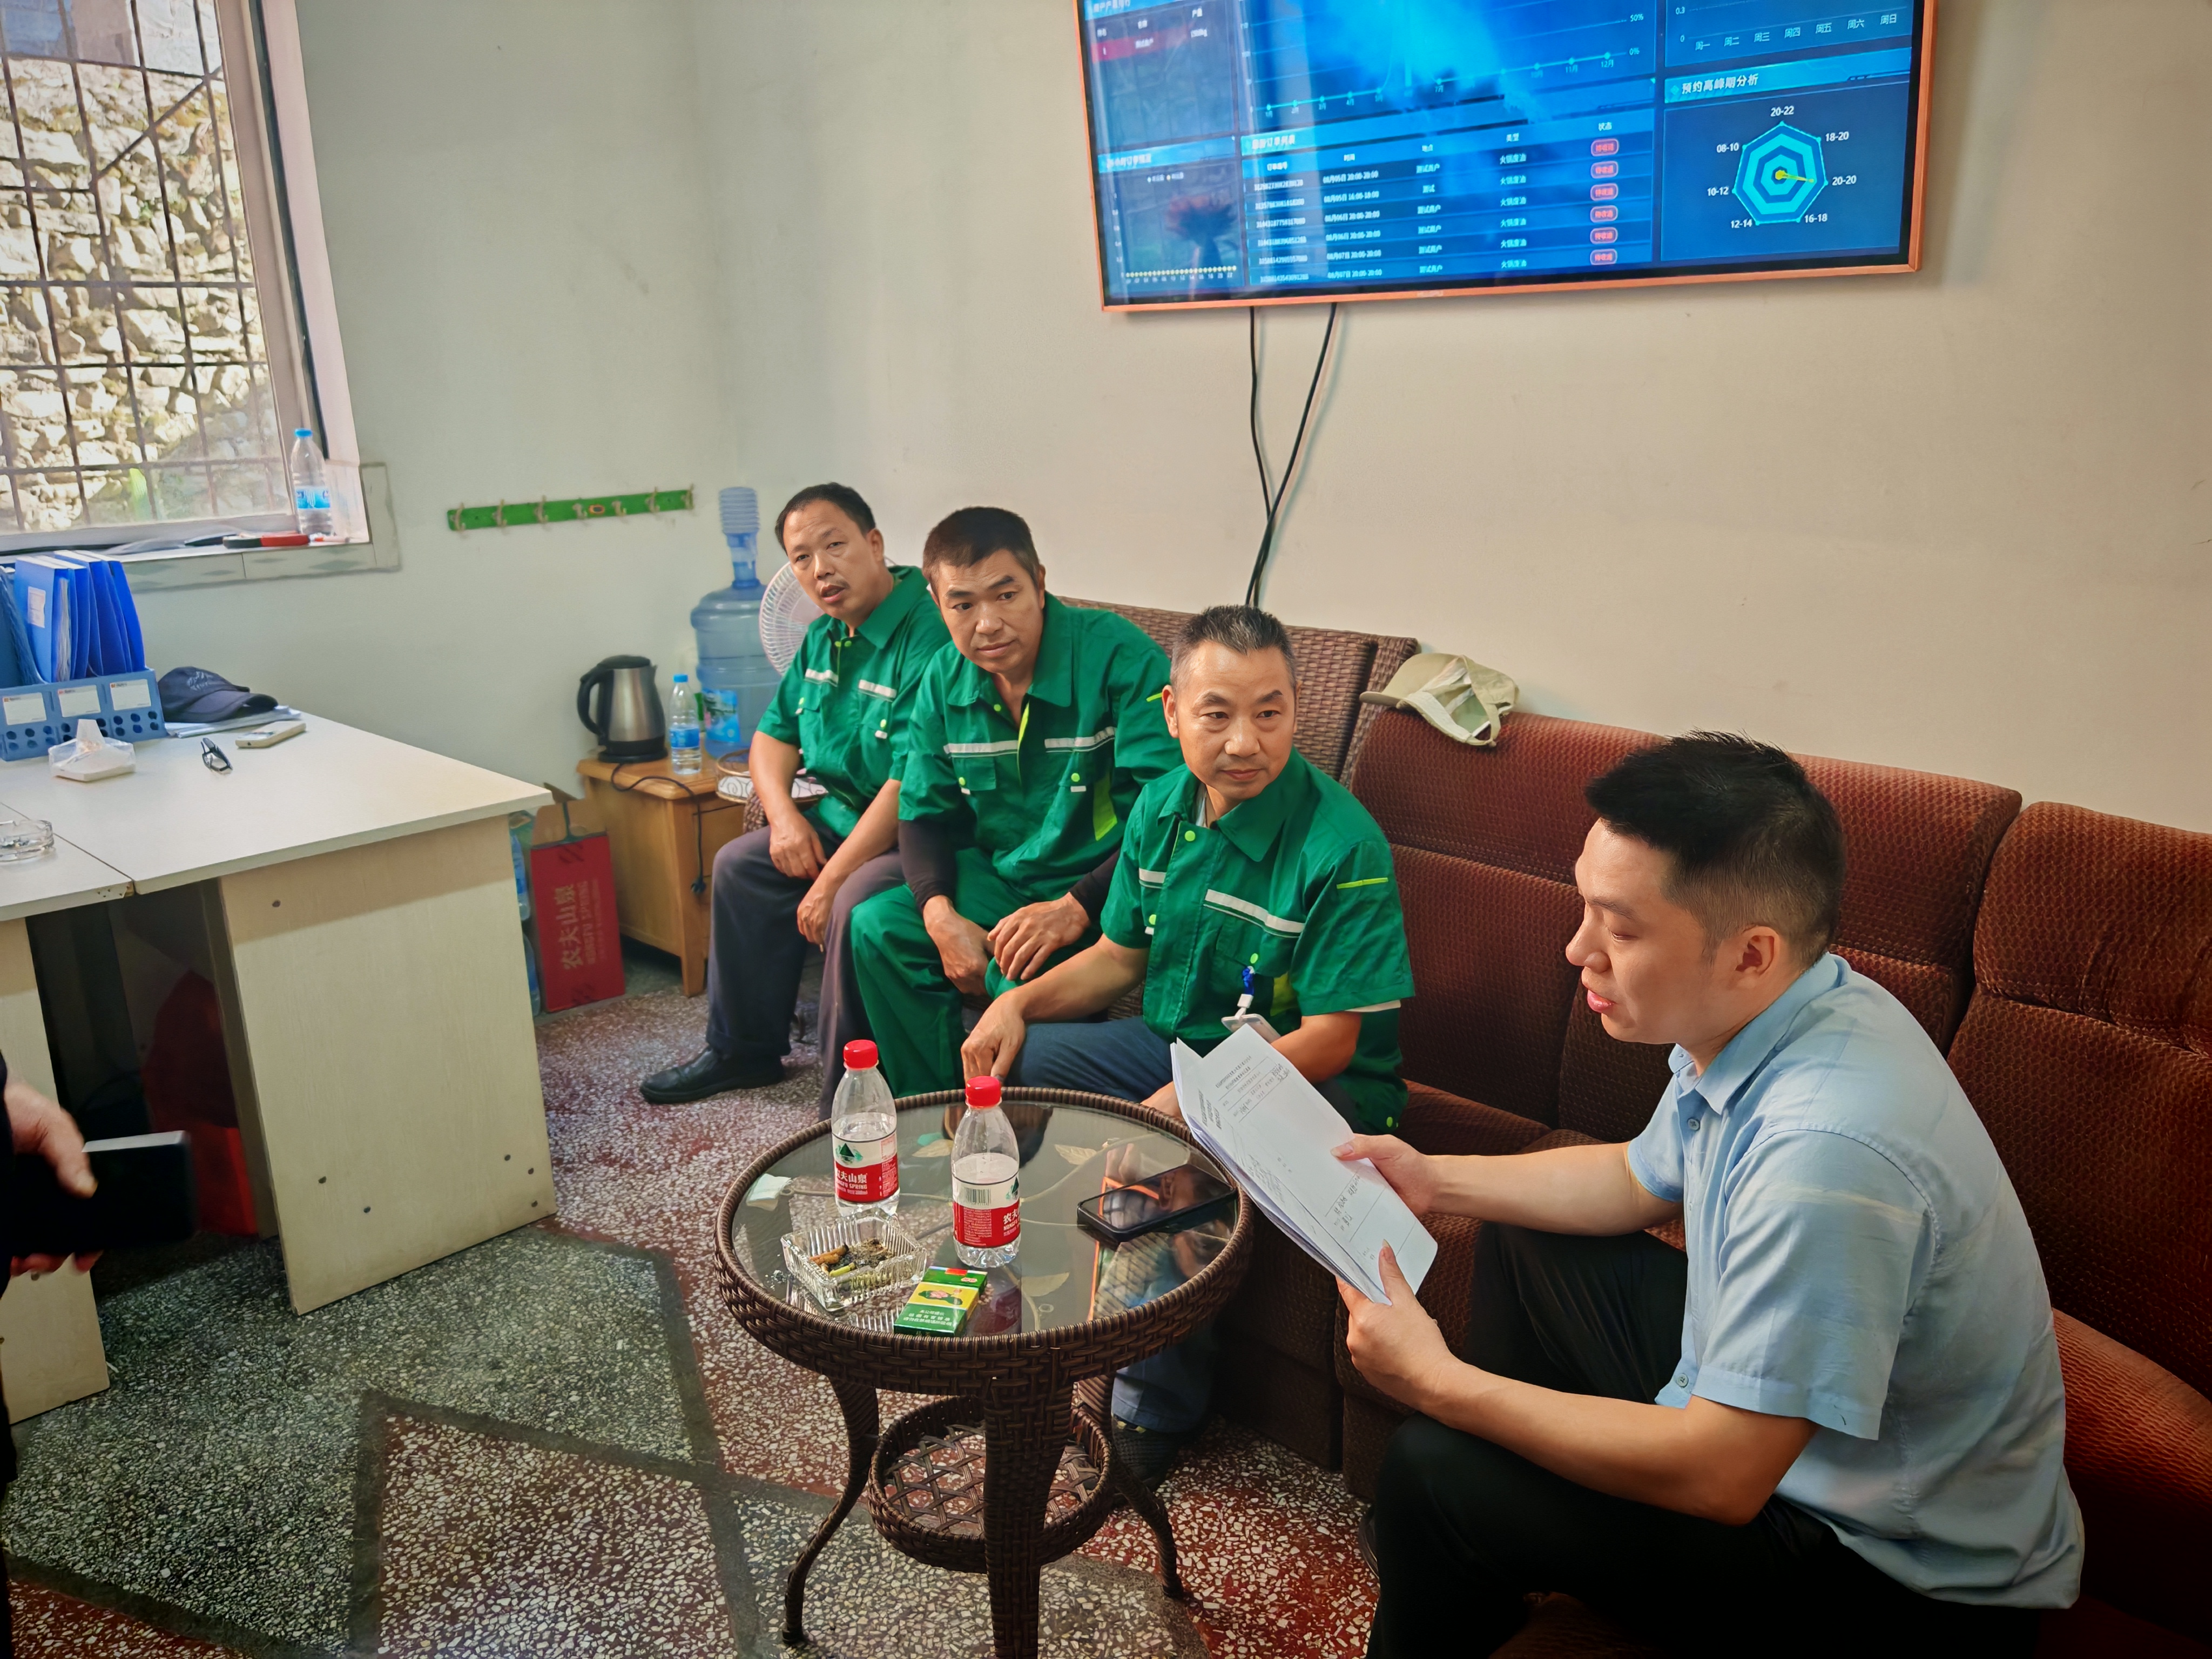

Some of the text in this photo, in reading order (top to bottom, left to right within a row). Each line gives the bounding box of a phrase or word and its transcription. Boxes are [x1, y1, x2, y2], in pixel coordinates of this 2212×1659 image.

[1630, 14, 1644, 22] 50%
[1695, 14, 1897, 51] 周一 周二 周三 周四 周五 周六 周日
[1566, 65, 1578, 73] 11月
[1601, 59, 1614, 68] 12月
[1681, 73, 1759, 95] 预约高峰期分析
[1771, 106, 1794, 117] 20-22
[1825, 131, 1849, 141] 18-20
[1717, 143, 1739, 153] 08-10
[1832, 176, 1857, 186] 20-20
[1707, 186, 1729, 196] 10-12
[1805, 213, 1827, 223] 16-18
[1731, 219, 1752, 228] 12-14
